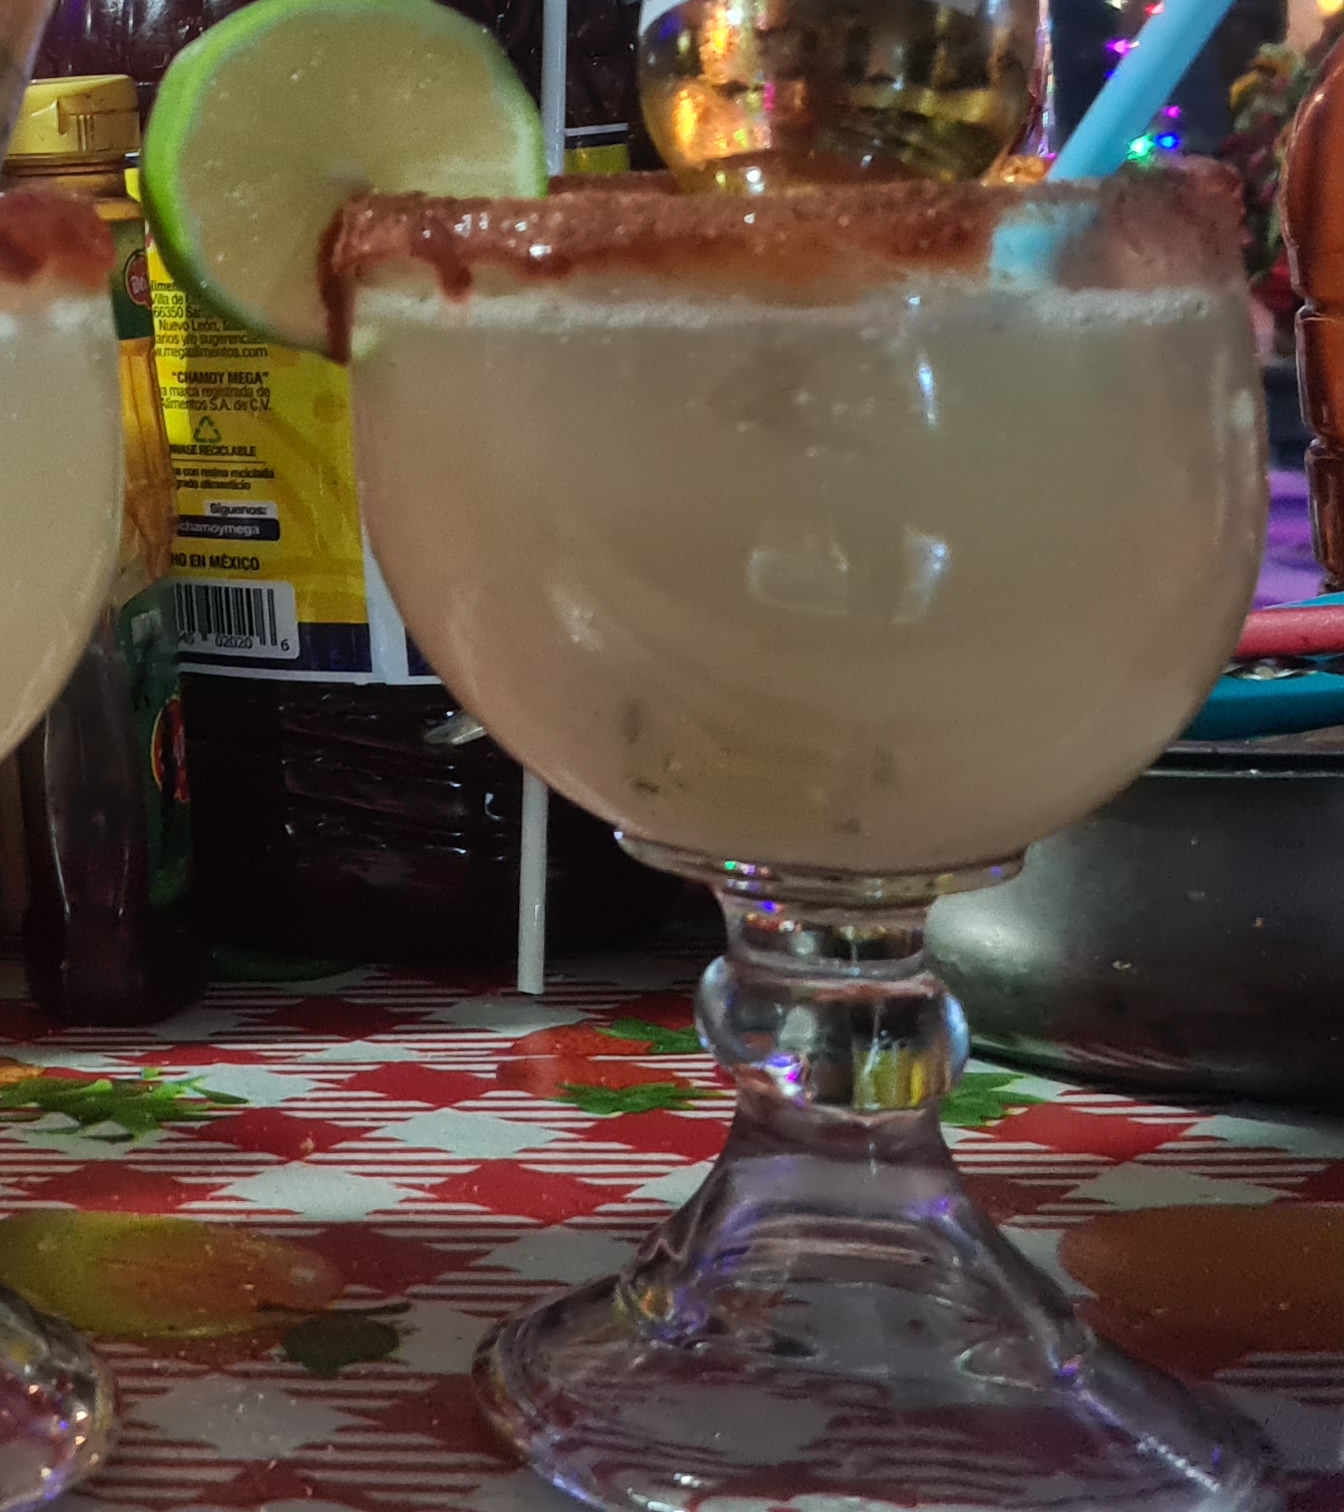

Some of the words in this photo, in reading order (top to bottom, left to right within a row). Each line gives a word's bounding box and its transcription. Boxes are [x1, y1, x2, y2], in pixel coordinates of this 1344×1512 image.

[189, 553, 207, 569] EN
[208, 551, 261, 571] MÉXICO
[215, 632, 254, 650] 02020
[279, 638, 291, 652] 6
